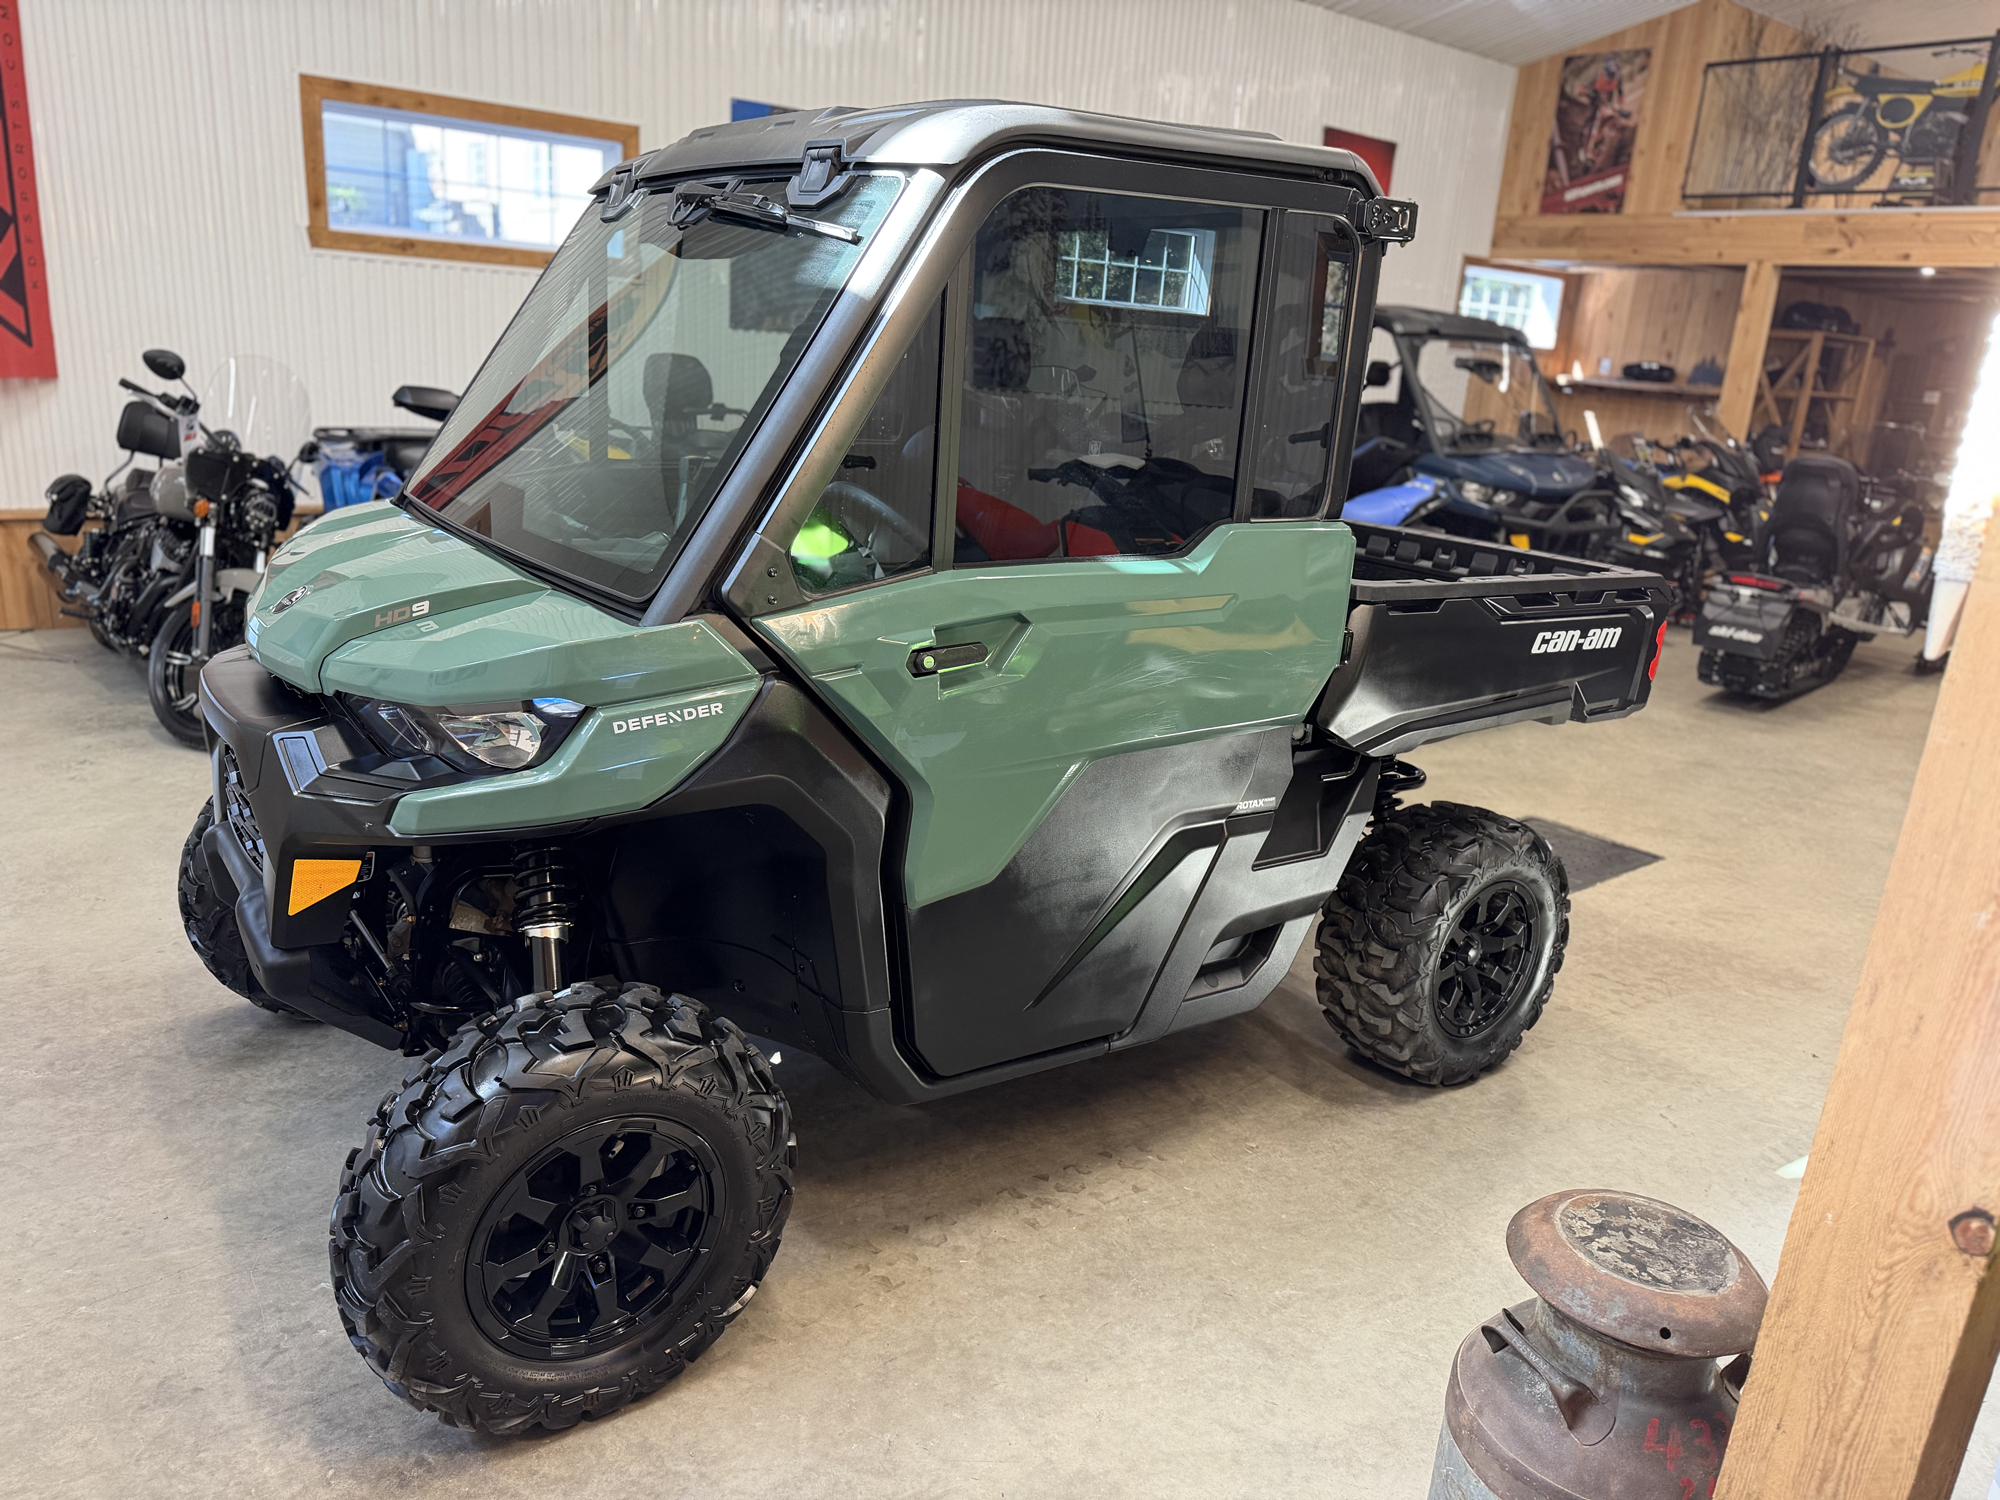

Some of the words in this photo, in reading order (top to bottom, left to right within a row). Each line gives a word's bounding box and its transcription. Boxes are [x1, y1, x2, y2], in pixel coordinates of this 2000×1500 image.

[375, 600, 430, 628] HD9
[1531, 626, 1622, 655] can-am
[612, 702, 724, 734] DEFENDER
[1236, 799, 1264, 810] ROTAX
